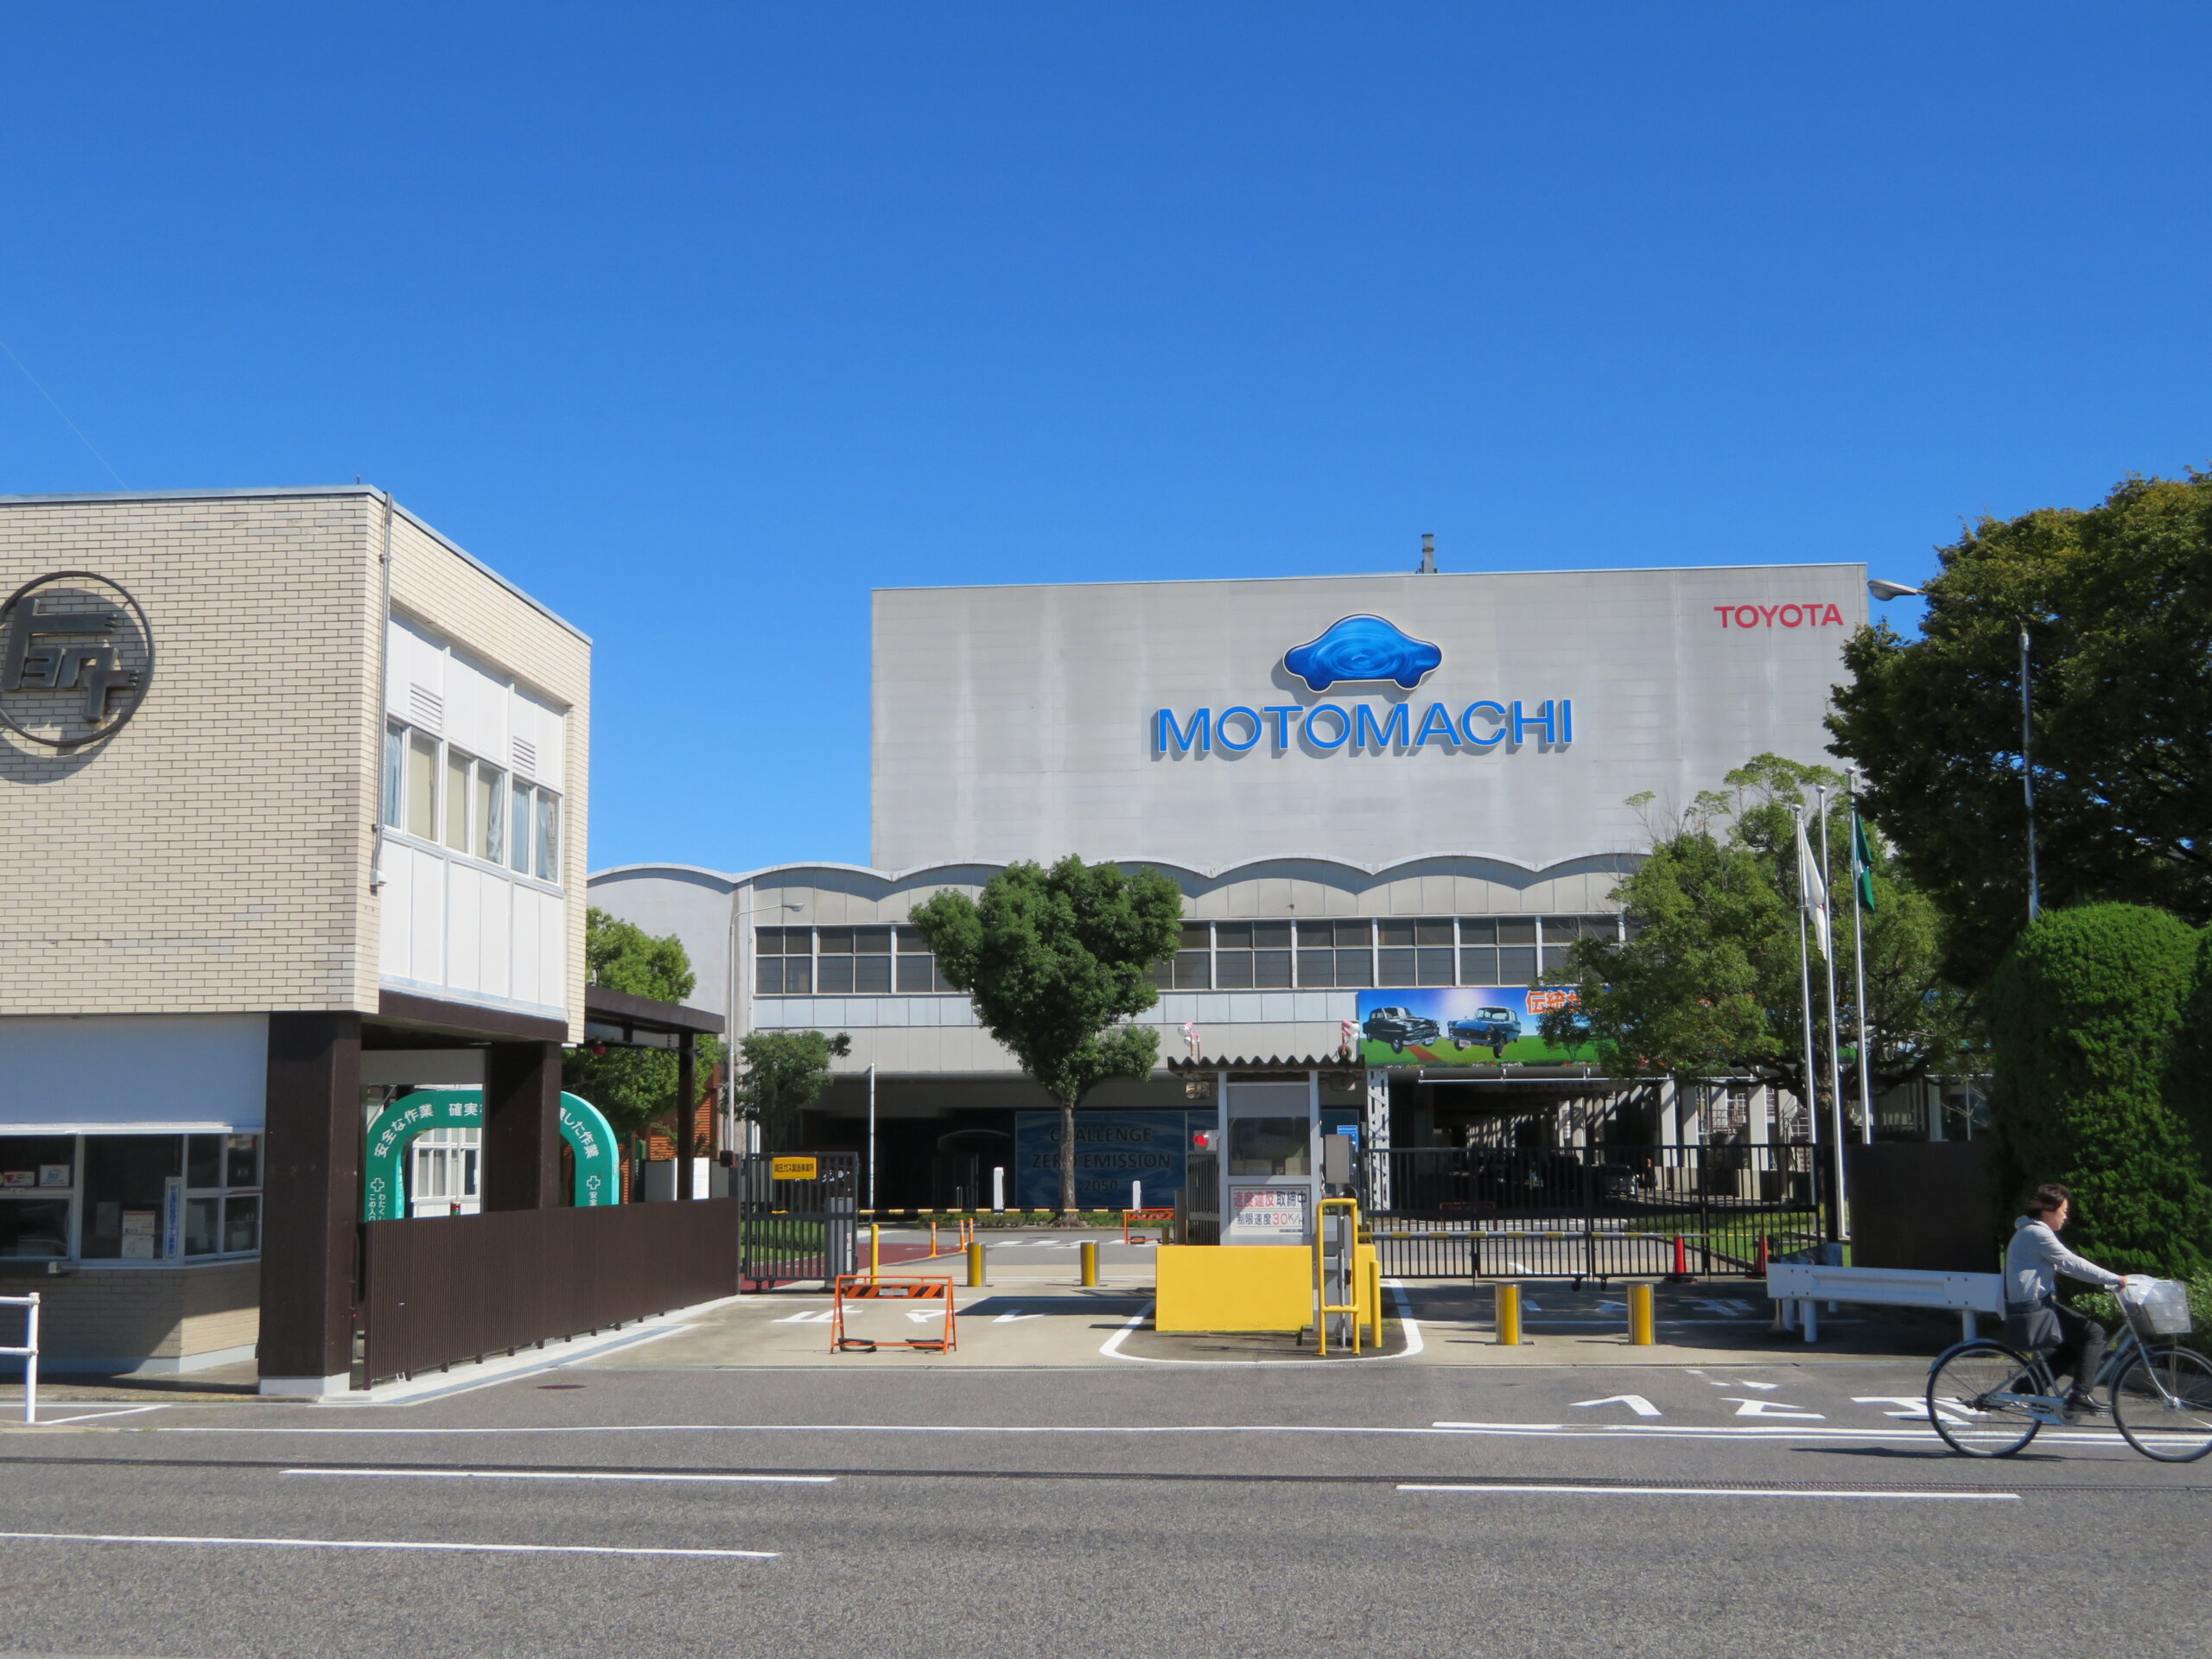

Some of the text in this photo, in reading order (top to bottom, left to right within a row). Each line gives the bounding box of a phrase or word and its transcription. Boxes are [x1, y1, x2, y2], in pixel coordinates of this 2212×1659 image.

[1713, 603, 1844, 629] TOYOTA
[1157, 698, 1573, 753] MOTOMACHI
[374, 1103, 435, 1159] 安全な作業
[448, 1103, 483, 1116] 確実
[1050, 1127, 1153, 1142] CALLENGE
[1084, 1154, 1171, 1168] EMISSION
[1084, 1179, 1118, 1192] 2050
[1233, 1191, 1307, 1208] 速度違反取締中
